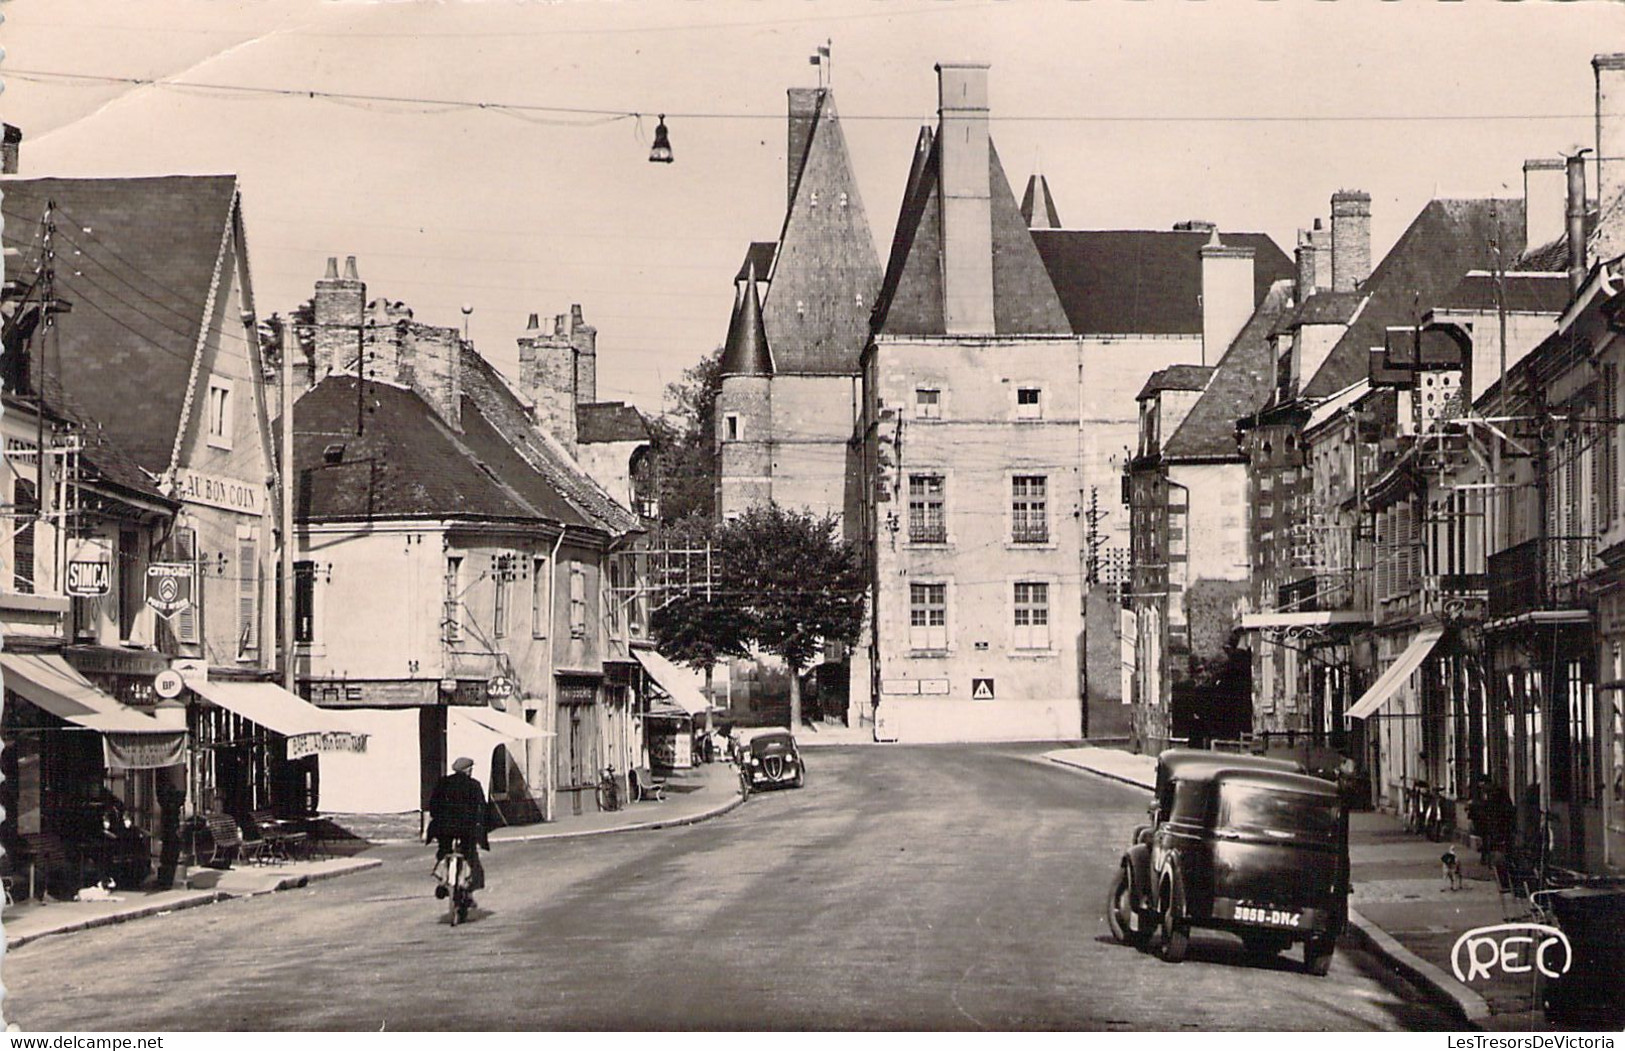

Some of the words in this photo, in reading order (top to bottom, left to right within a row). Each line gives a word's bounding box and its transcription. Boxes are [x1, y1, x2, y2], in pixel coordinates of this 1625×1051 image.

[188, 475, 202, 497] AU
[206, 479, 227, 503] BON
[230, 485, 255, 508] COIN
[69, 562, 108, 588] SIMCA
[162, 681, 175, 691] BP
[487, 684, 511, 696] JAZ
